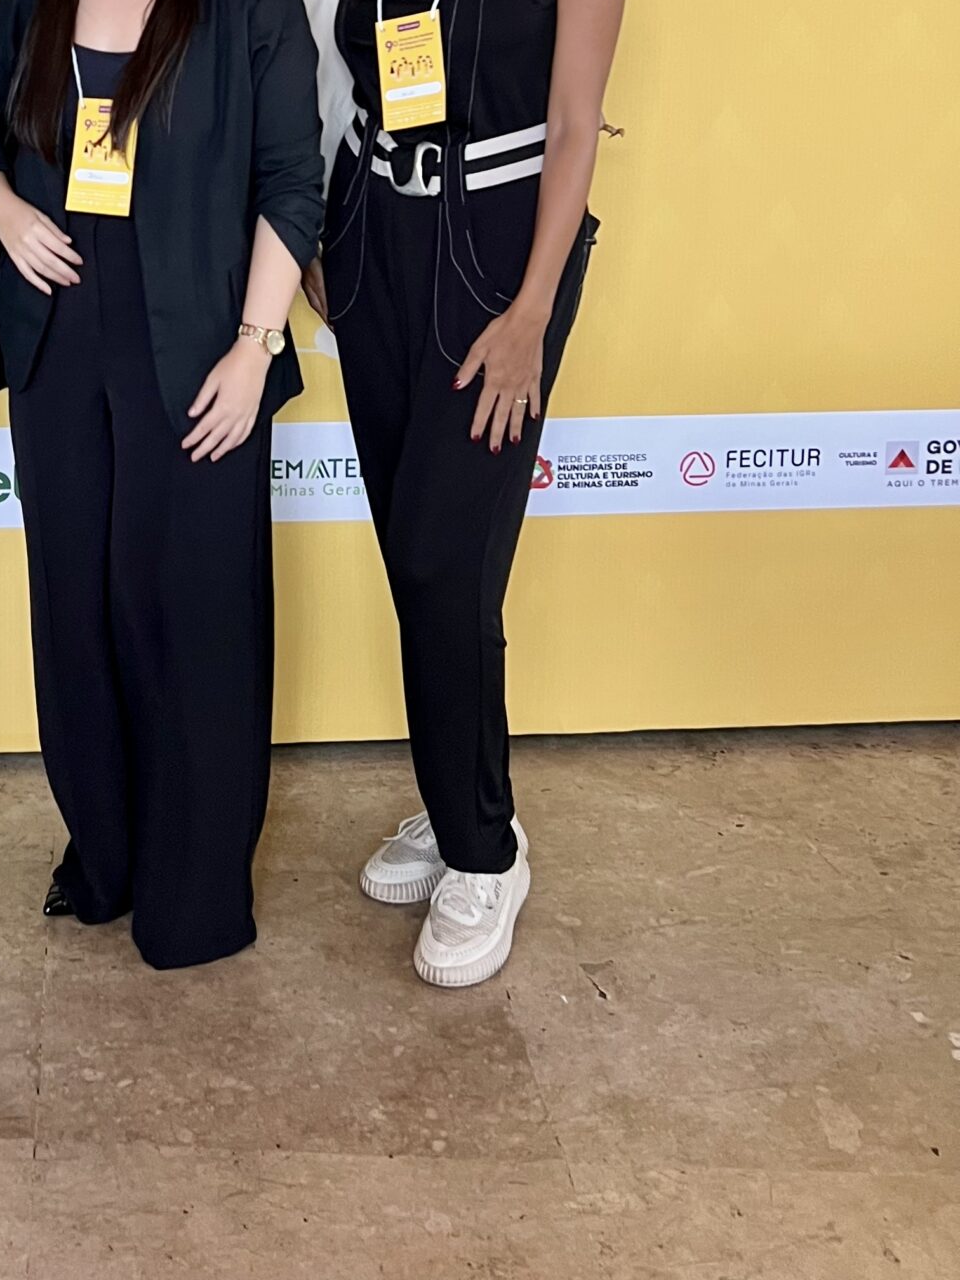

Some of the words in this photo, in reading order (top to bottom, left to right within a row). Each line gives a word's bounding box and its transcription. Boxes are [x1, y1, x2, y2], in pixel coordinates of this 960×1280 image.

[927, 440, 960, 455] GO
[558, 455, 582, 463] REDE
[585, 455, 597, 463] DE
[600, 453, 647, 462] GESTORES
[726, 448, 821, 468] FECITUR
[271, 458, 363, 480] EMATE
[557, 463, 613, 471] MUNICIPAIS
[926, 460, 952, 474] DE
[557, 472, 600, 480] CULTURA
[611, 470, 653, 479] TURISMO
[572, 480, 603, 488] MINAS
[605, 479, 639, 487] GERAIS
[271, 484, 315, 496] Minas
